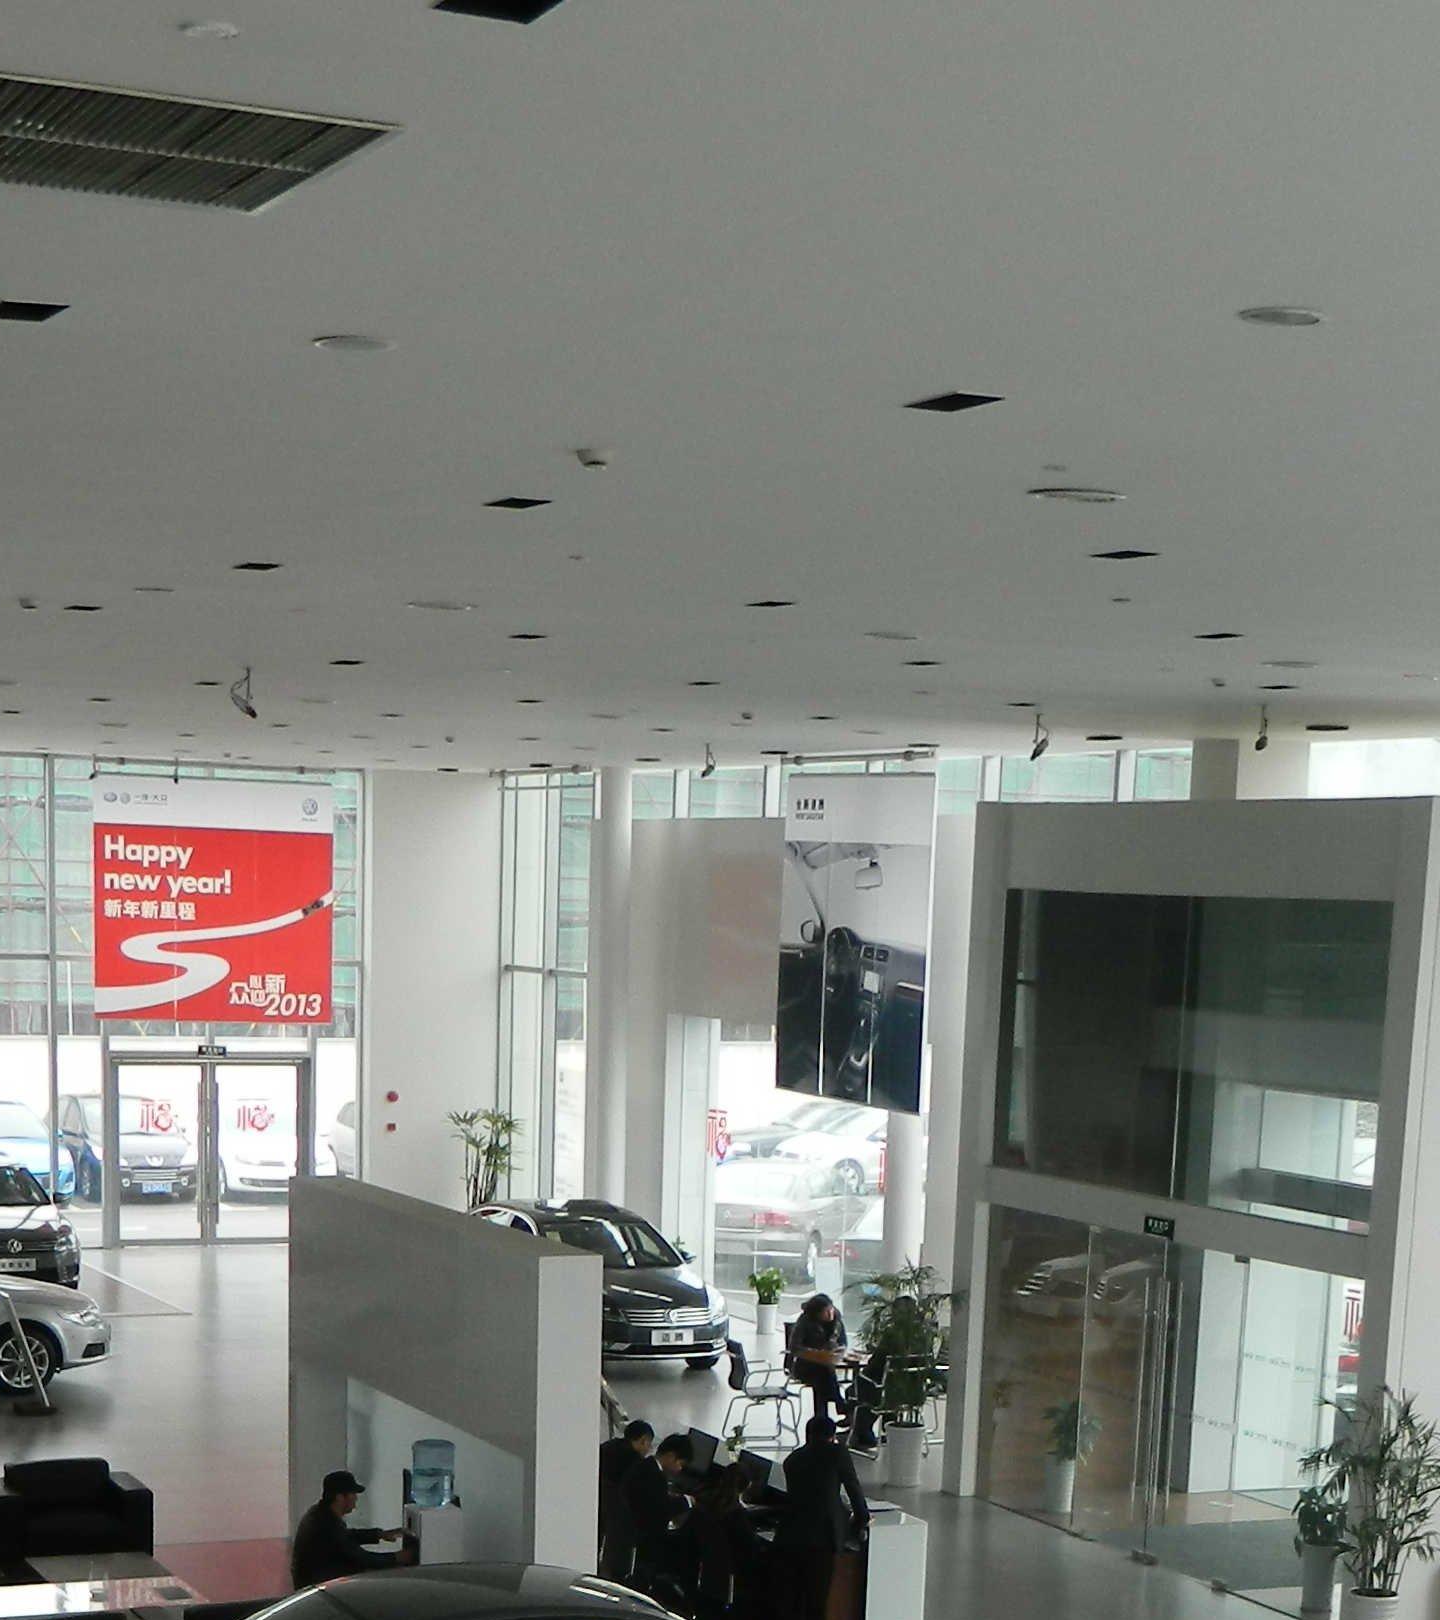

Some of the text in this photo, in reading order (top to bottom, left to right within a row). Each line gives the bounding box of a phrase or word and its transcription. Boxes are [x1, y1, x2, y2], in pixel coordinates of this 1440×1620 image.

[103, 833, 194, 870] Happy
[103, 868, 232, 899] new year!
[103, 898, 197, 921] 新年新里程
[264, 993, 322, 1017] 2013
